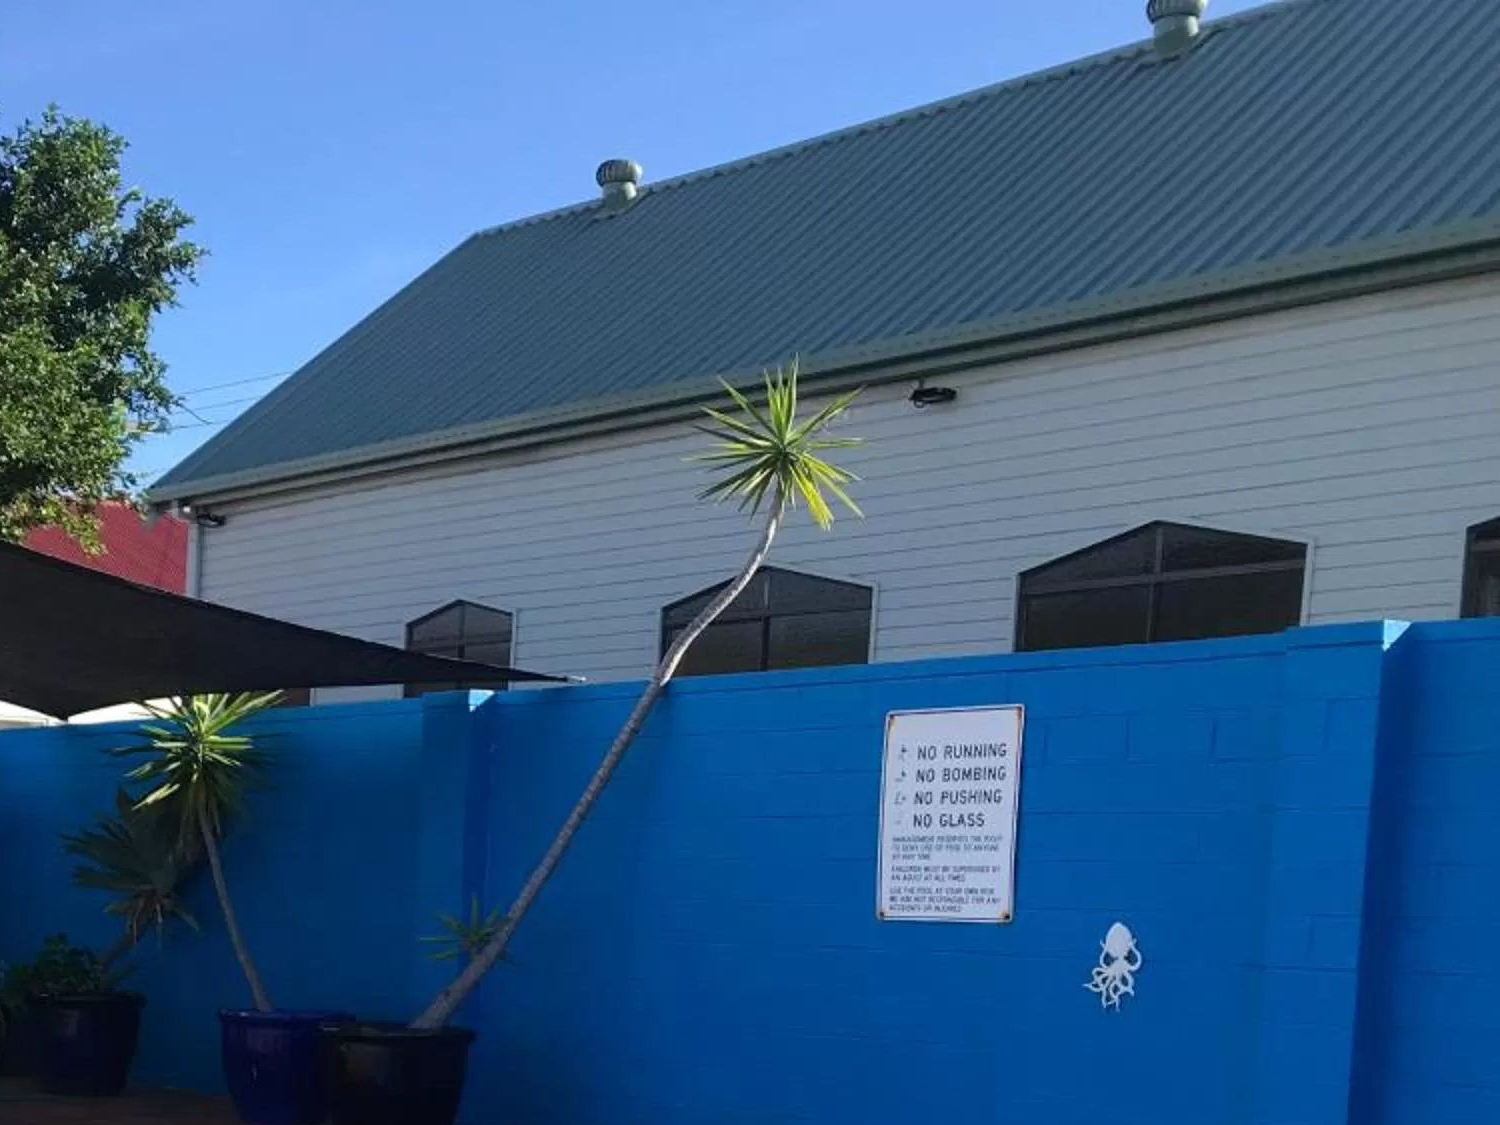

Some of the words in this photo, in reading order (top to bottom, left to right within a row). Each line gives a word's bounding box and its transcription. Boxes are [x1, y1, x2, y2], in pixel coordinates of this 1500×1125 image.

[917, 745, 937, 760] NO
[943, 743, 1007, 759] RUNNING
[916, 768, 935, 782] NO
[942, 766, 1006, 782] BOMBING
[913, 791, 933, 805] NO
[940, 789, 1003, 805] PUSHING
[913, 813, 933, 828] NO
[939, 812, 985, 827] GLASS
